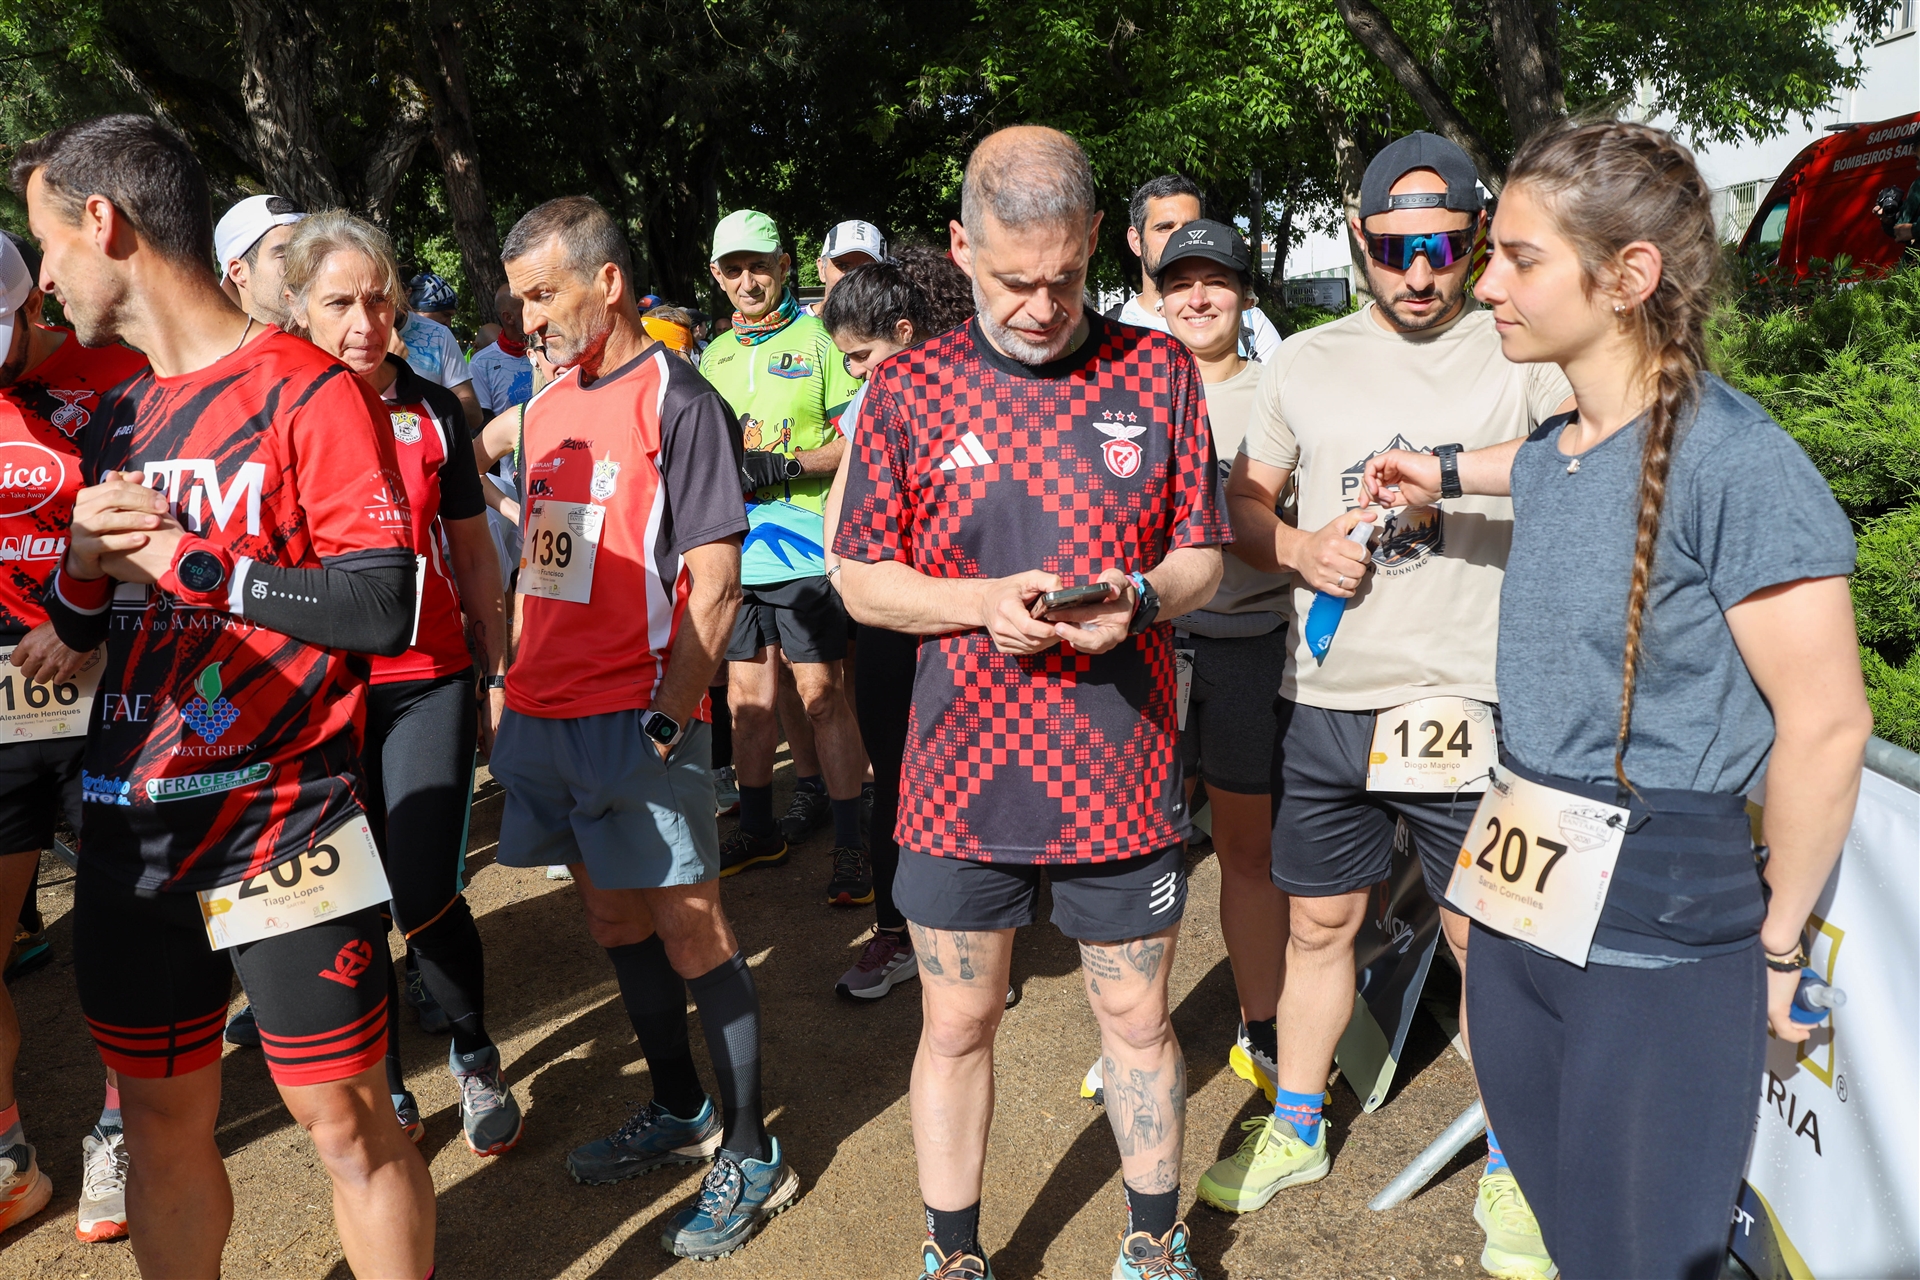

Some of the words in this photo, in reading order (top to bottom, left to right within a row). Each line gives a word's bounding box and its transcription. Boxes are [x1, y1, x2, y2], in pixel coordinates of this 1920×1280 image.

[1867, 121, 1920, 145] SAPADOR
[1833, 147, 1893, 172] BOMBEIROS
[532, 529, 572, 568] 139
[541, 569, 564, 577] Francisco
[1386, 558, 1428, 576] RUNNING
[0, 675, 79, 711] 166
[0, 712, 39, 721] Alexandre
[41, 708, 80, 718] Henriques
[171, 744, 257, 757] NEXTGREEN
[1394, 720, 1472, 757] 124
[1404, 761, 1428, 769] Diogo
[1430, 761, 1461, 770] Magriço
[1476, 816, 1568, 893] 207
[263, 893, 291, 907] Tiago
[293, 884, 325, 899] Lopes
[1478, 875, 1498, 892] Sarah
[1499, 885, 1544, 910] Cornelles
